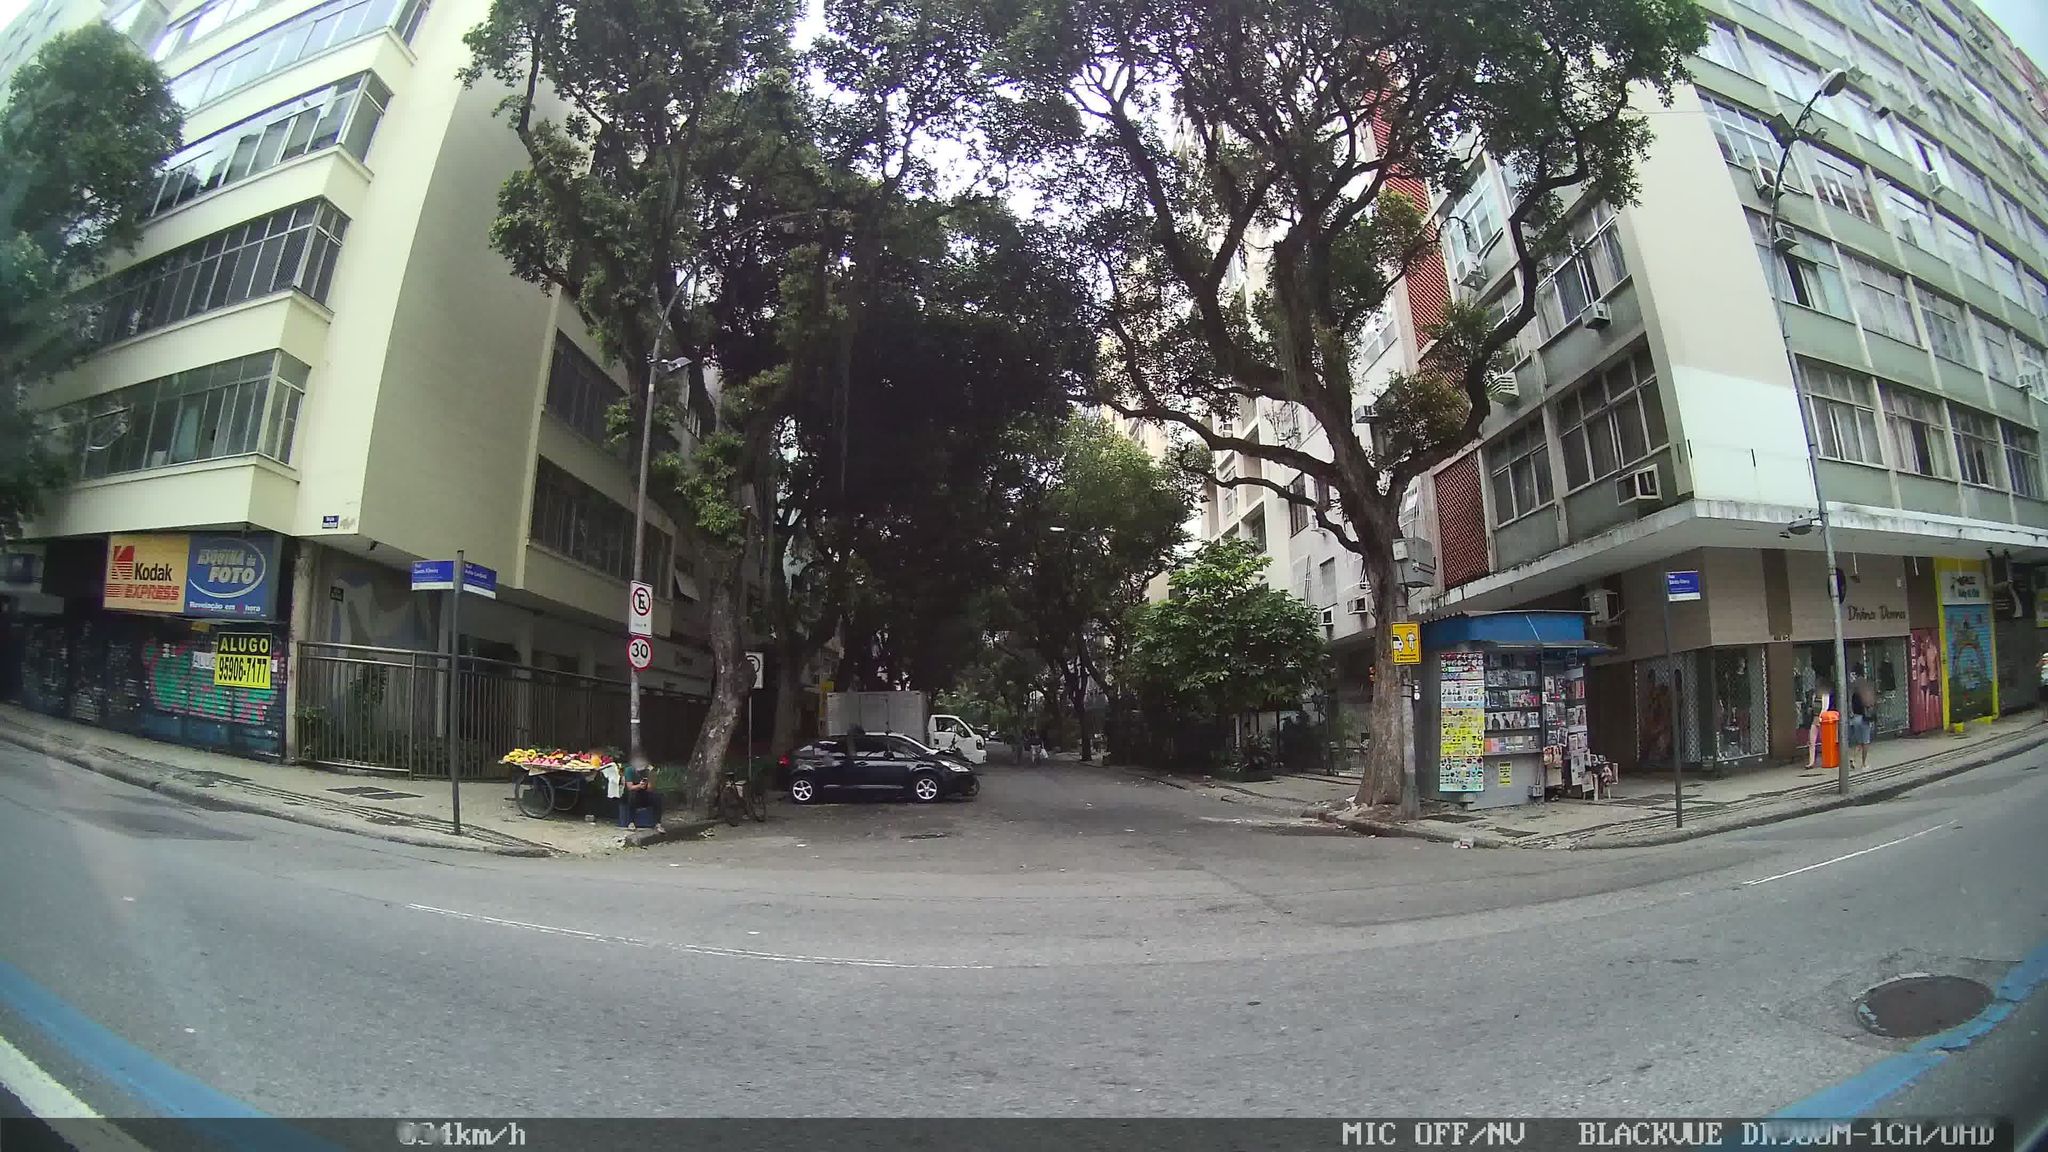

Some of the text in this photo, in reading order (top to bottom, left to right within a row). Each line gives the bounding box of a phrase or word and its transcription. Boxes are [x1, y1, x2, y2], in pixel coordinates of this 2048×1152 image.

[134, 563, 173, 582] Kodak
[208, 566, 256, 585] FOTO
[123, 584, 180, 601] EXPRESS
[189, 601, 224, 612] Revelação
[245, 604, 261, 612] hora
[220, 637, 270, 654] ALUGO
[631, 642, 649, 659] 30
[218, 656, 268, 684] 95906-7177
